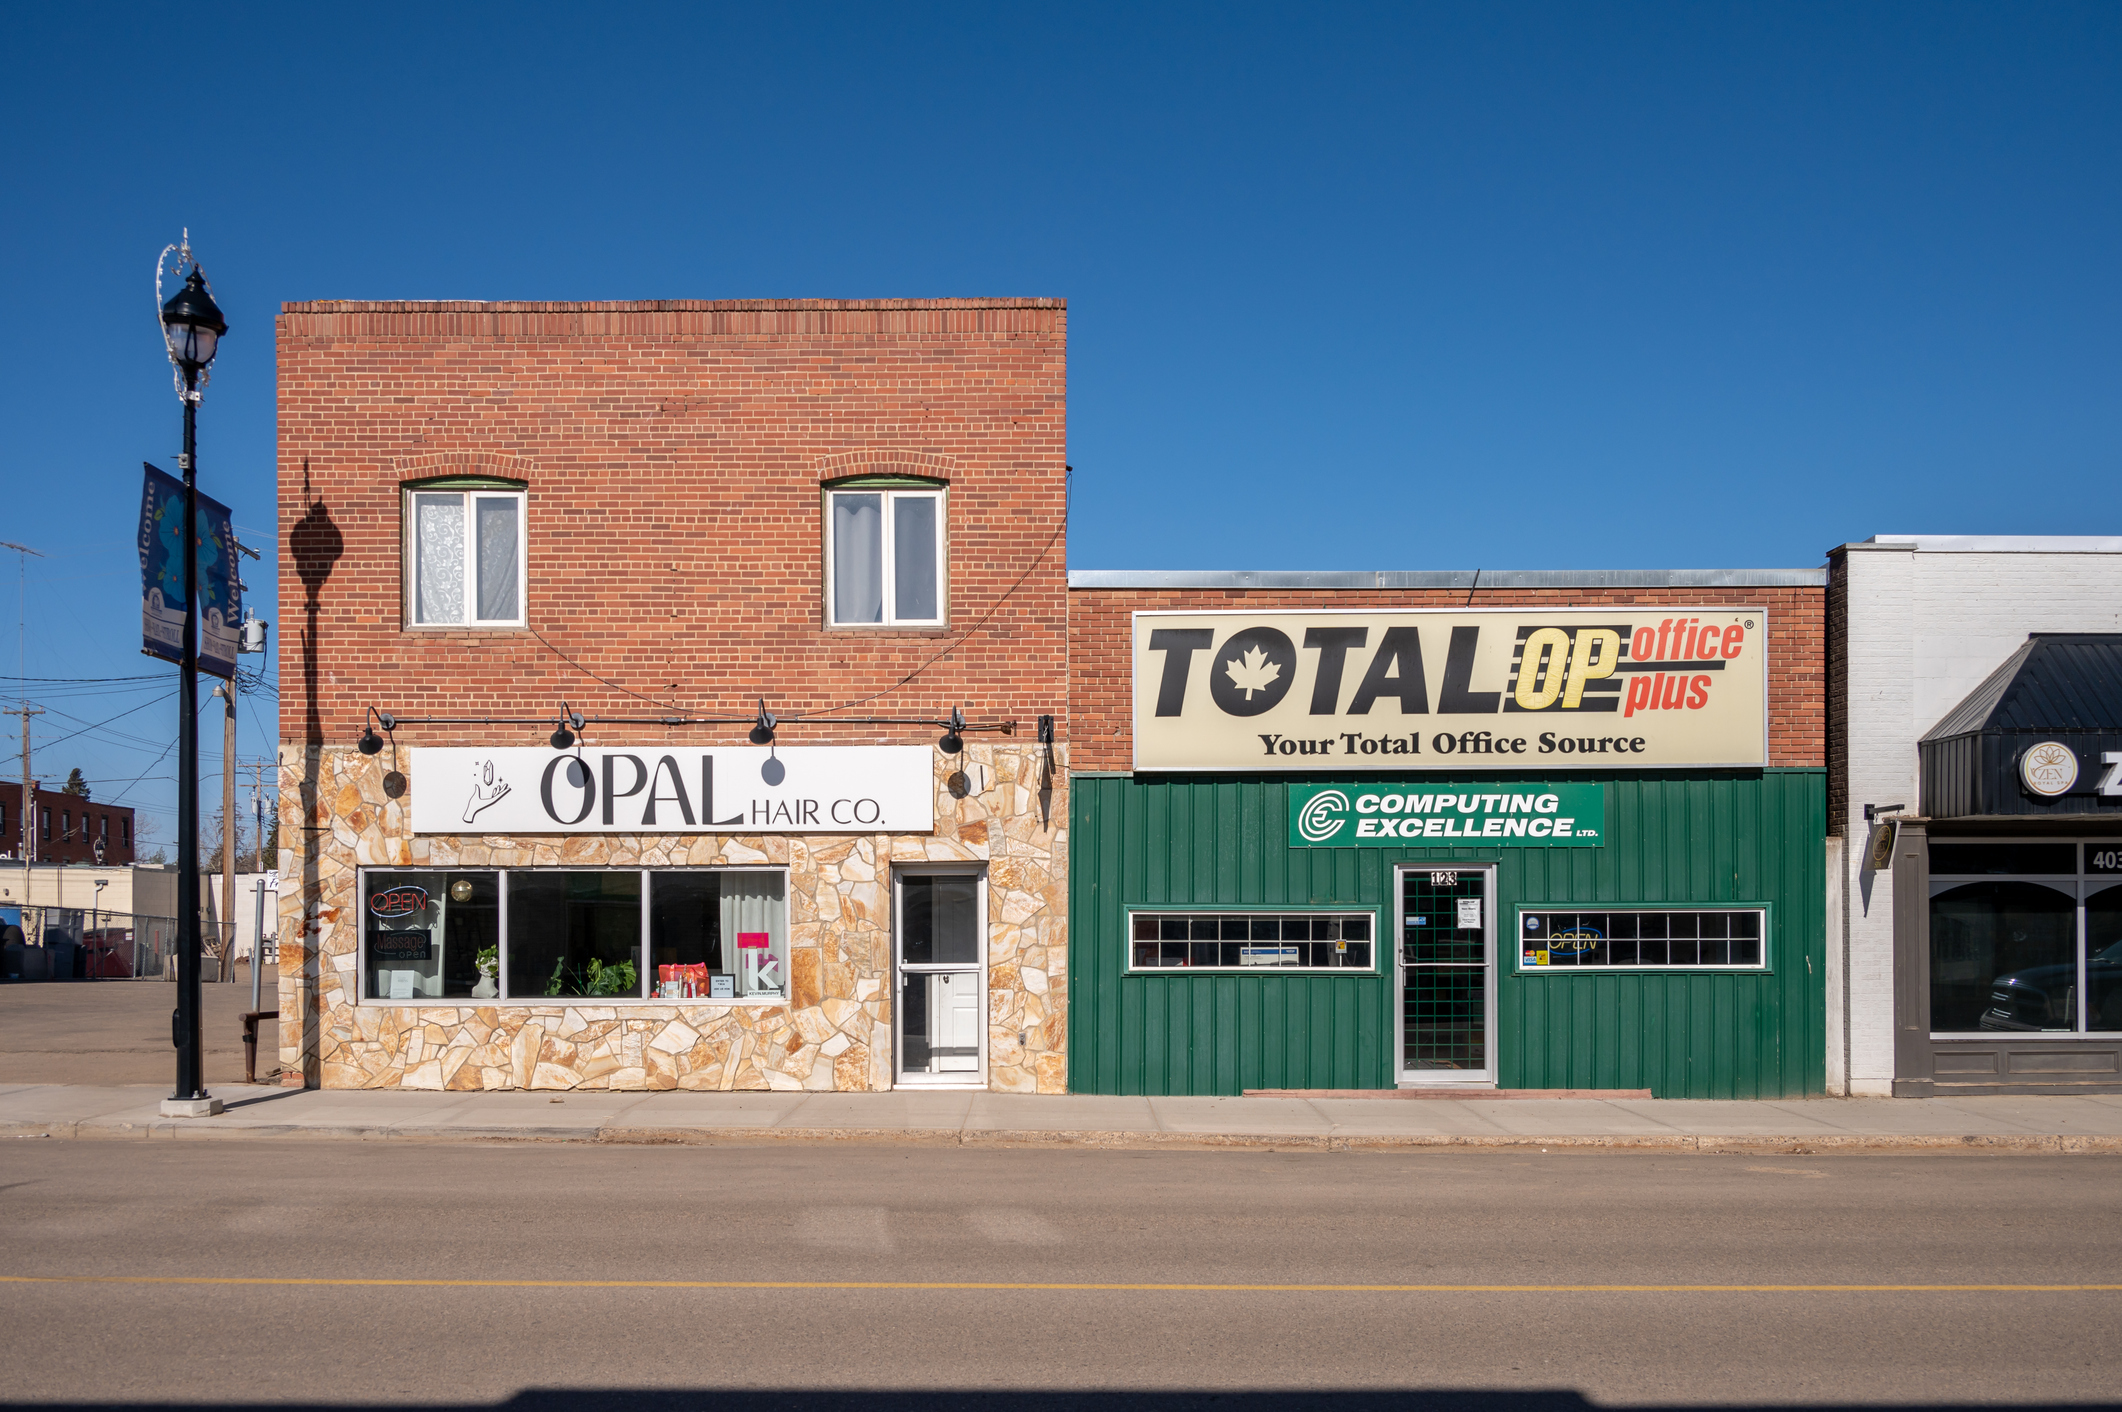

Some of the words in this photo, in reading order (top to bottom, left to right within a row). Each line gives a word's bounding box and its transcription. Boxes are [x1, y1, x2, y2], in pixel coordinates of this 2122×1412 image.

[223, 520, 240, 623] Welcome
[1148, 626, 1502, 718] TOTAL
[1514, 628, 1620, 709] OP
[1623, 672, 1712, 718] plus
[1258, 733, 1334, 756] Your
[1340, 731, 1421, 755] Total
[1432, 731, 1528, 754] Office
[1537, 730, 1646, 754] Source
[2037, 768, 2063, 780] ZEN
[540, 754, 744, 826] OPAL
[752, 799, 820, 825] HAIR
[831, 798, 887, 825] CO.
[1355, 794, 1560, 814] COMPUTING
[1355, 817, 1575, 839] EXCELLENCE
[1577, 828, 1600, 838] LTD.
[1432, 872, 1457, 885] 123
[370, 892, 427, 911] OPEN
[376, 933, 424, 951] Massage
[1549, 933, 1598, 950] OPEN
